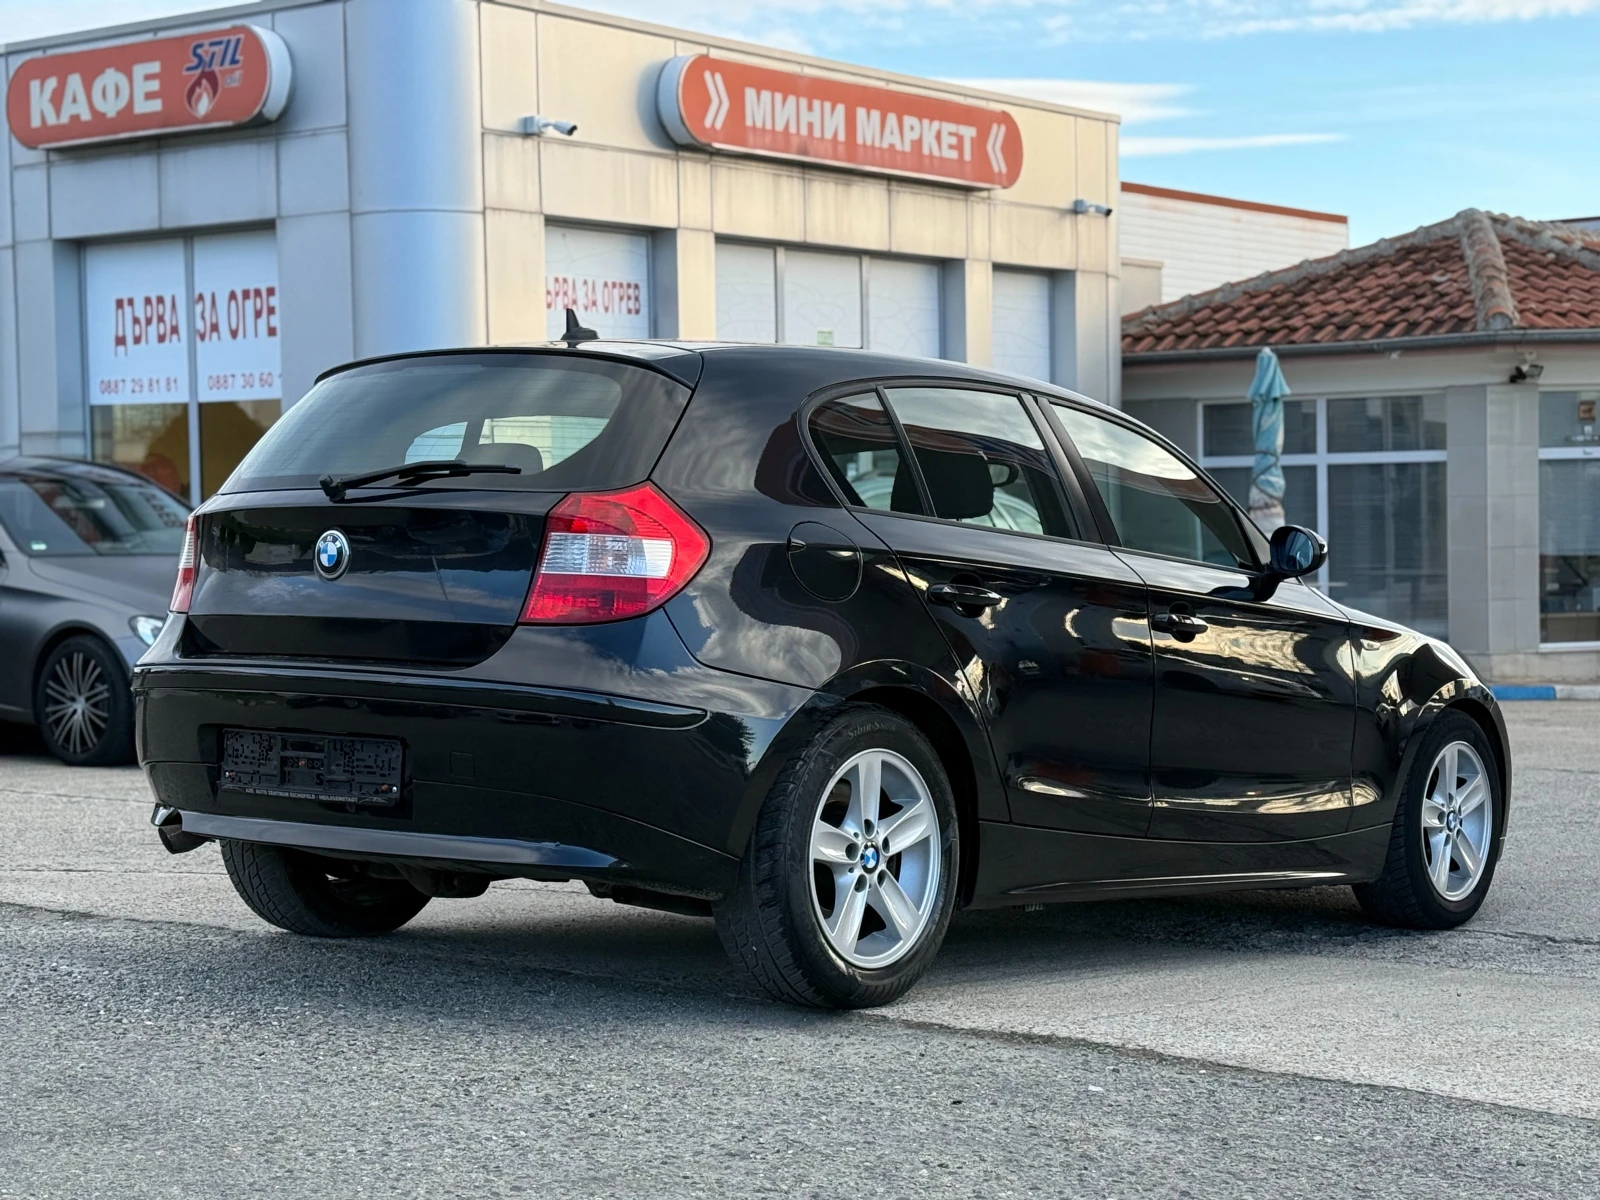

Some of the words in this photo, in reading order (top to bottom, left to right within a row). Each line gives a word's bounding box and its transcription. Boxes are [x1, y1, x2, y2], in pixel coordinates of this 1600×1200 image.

[183, 36, 243, 73] STIL
[29, 61, 163, 129] КАФЕ
[744, 86, 846, 142] МИНИ
[856, 106, 977, 162] МАРКЕТ
[583, 279, 598, 312] ЗА
[602, 281, 641, 315] ОГРЕВ
[114, 294, 181, 357] ДЪРВА
[195, 291, 221, 343] ЗА
[99, 378, 126, 394] 0887
[131, 378, 144, 394] 29
[207, 373, 236, 390] 0887
[242, 372, 255, 389] 30
[259, 371, 273, 388] 60
